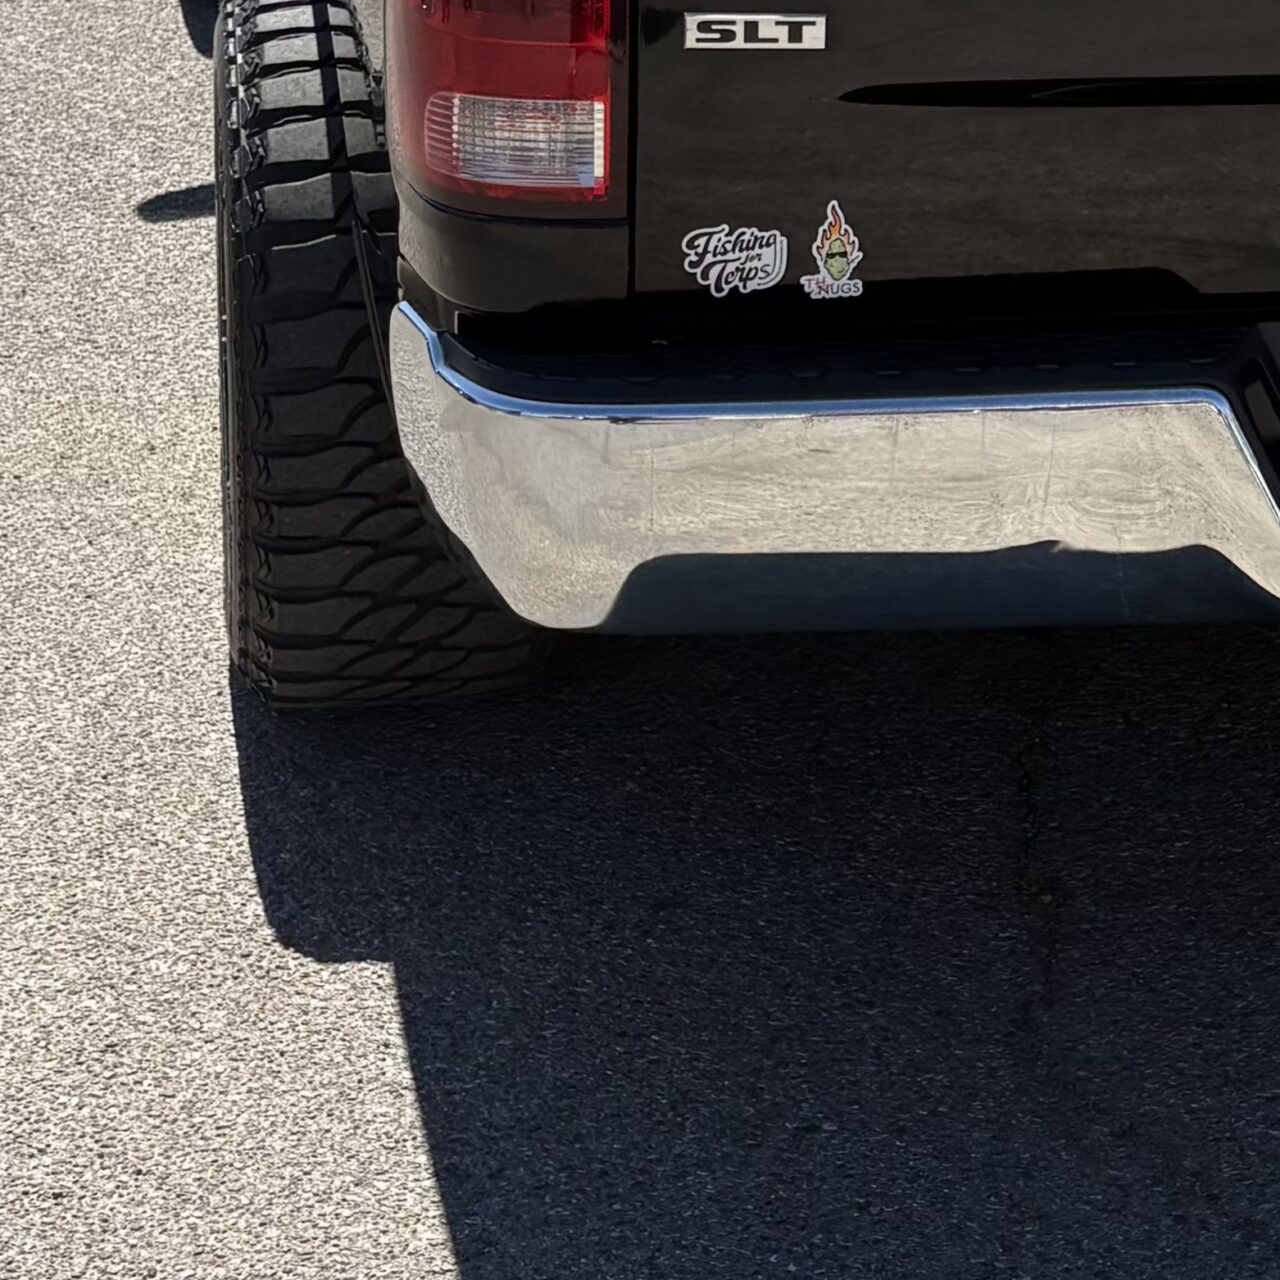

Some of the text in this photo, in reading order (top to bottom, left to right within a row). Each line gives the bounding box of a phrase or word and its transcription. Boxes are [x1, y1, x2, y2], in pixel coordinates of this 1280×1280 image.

[694, 19, 818, 45] SLT
[684, 227, 778, 270] Fishing
[699, 257, 773, 294] Terps
